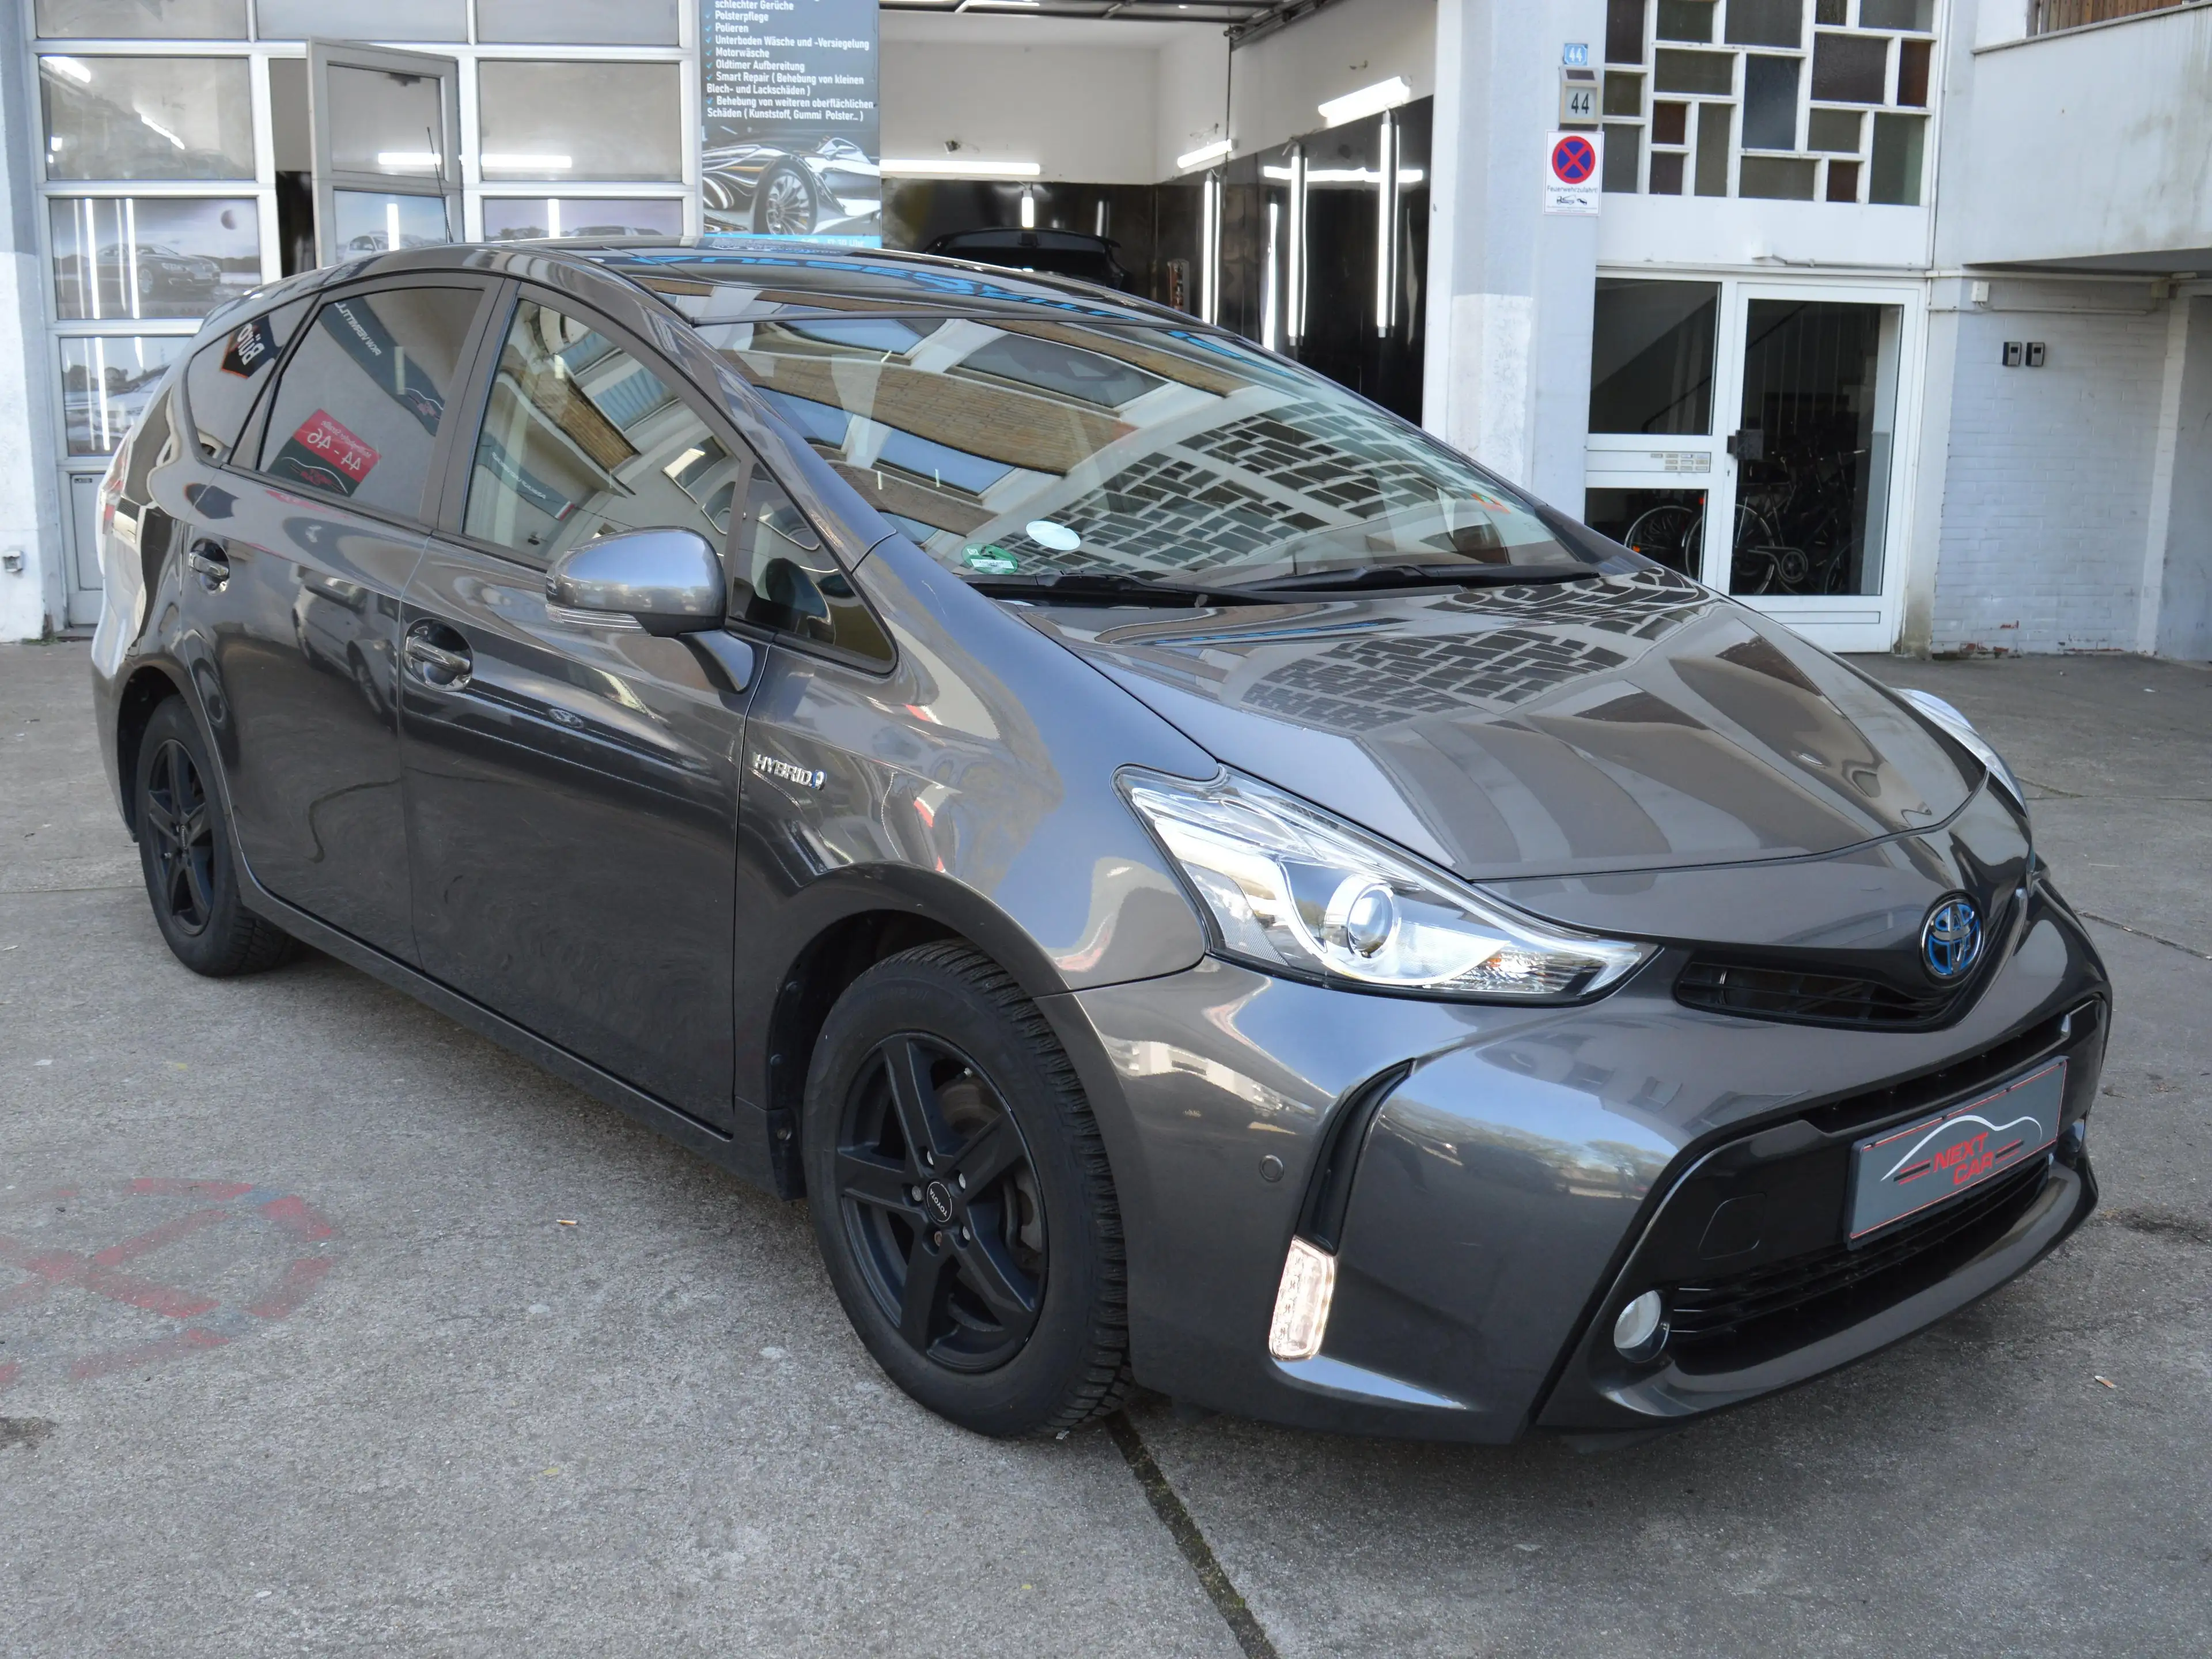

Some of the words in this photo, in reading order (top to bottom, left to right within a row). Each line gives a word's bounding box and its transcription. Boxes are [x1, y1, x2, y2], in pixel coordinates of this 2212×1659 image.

[715, 0, 758, 9] schlechter
[760, 0, 794, 10] Gerüche
[715, 10, 769, 23] Polsterpflege
[715, 22, 749, 33] Polieren
[715, 35, 763, 46] Unterboden
[764, 36, 795, 47] Wäsche
[797, 37, 813, 47] und
[715, 47, 770, 58] Motorwäsche
[1568, 47, 1583, 62] 44
[716, 59, 751, 70] Oldtimer
[753, 60, 805, 73] Aufbereitung
[716, 71, 741, 82] Smart
[743, 72, 770, 84] Repair
[777, 73, 817, 86] Behebung
[818, 75, 833, 84] von
[835, 74, 864, 85] kleinen
[706, 83, 734, 93] Blech-
[736, 84, 751, 94] und
[753, 84, 805, 95] Lackschäden
[717, 95, 756, 108] Behebung
[758, 98, 773, 107] von
[775, 97, 810, 107] weiteren
[812, 98, 873, 109] oberflächlichen
[1571, 92, 1589, 114] 44
[707, 107, 742, 118] Schäden
[793, 109, 822, 120] Gummi
[753, 753, 813, 788] HYBRID
[1933, 1131, 1989, 1173] NEXT
[1953, 1152, 1995, 1185] CAR
[929, 1188, 948, 1217] TOYOTA
